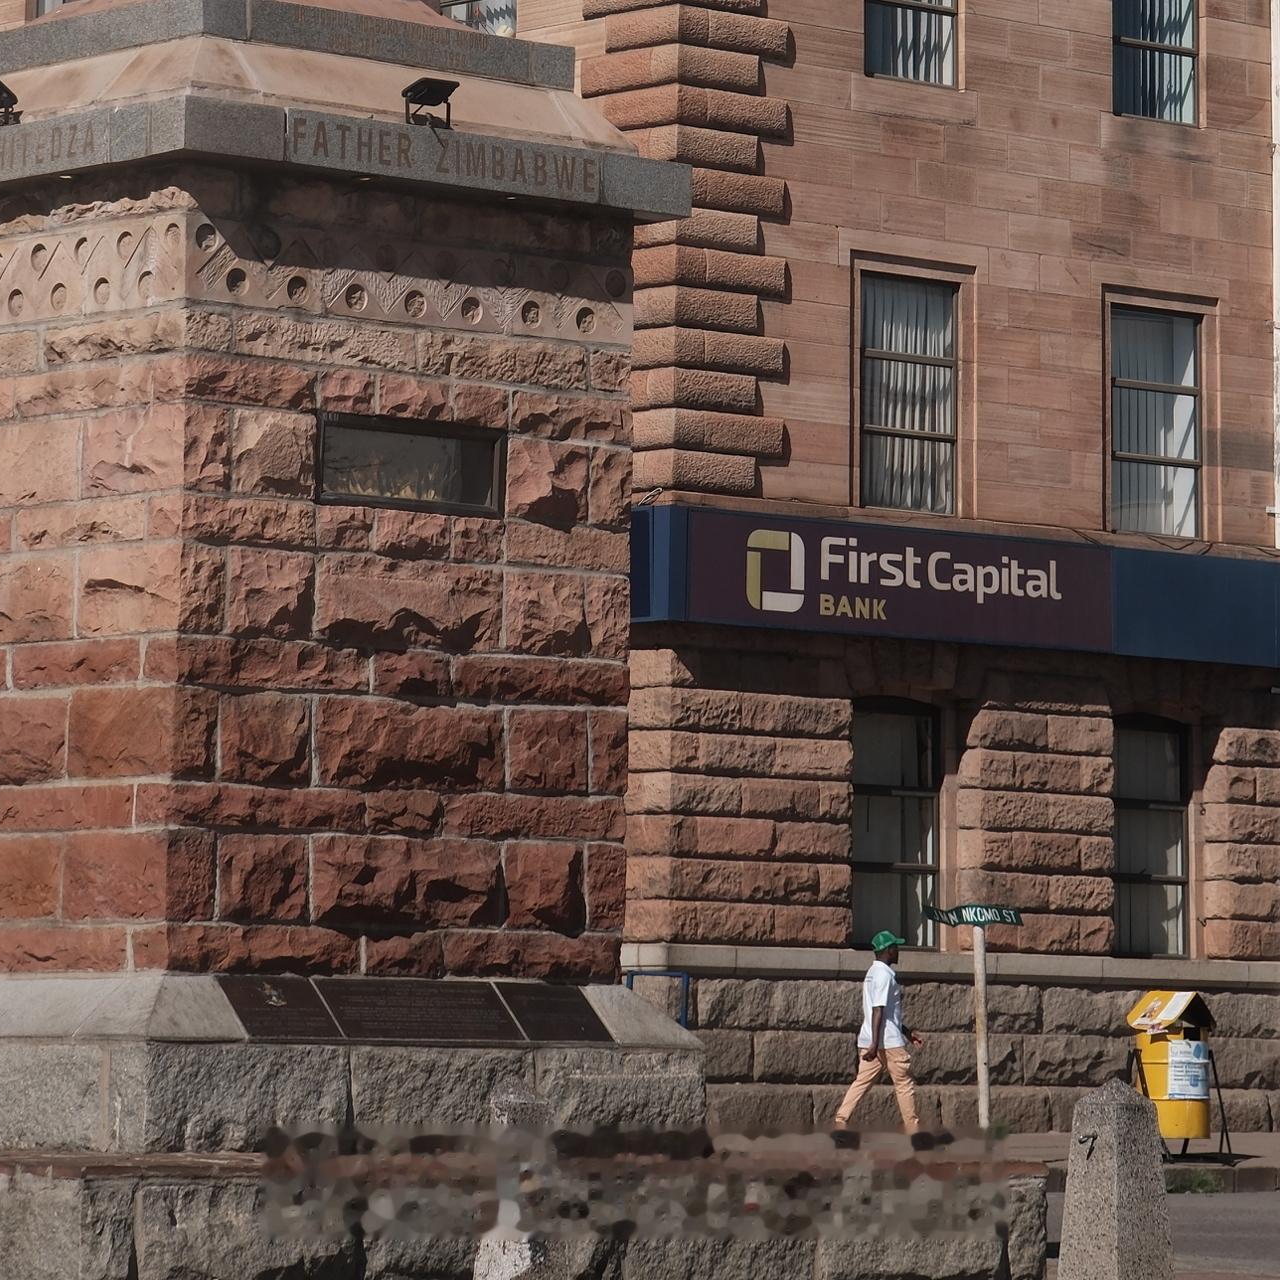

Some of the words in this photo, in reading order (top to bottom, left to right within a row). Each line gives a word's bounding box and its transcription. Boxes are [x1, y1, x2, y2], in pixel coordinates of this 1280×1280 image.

[292, 117, 412, 169] FATHER
[434, 134, 597, 194] ZIMBABWE
[820, 536, 921, 589] First
[926, 551, 1063, 604] Capital
[819, 593, 888, 621] BANK
[1002, 909, 1018, 924] ST
